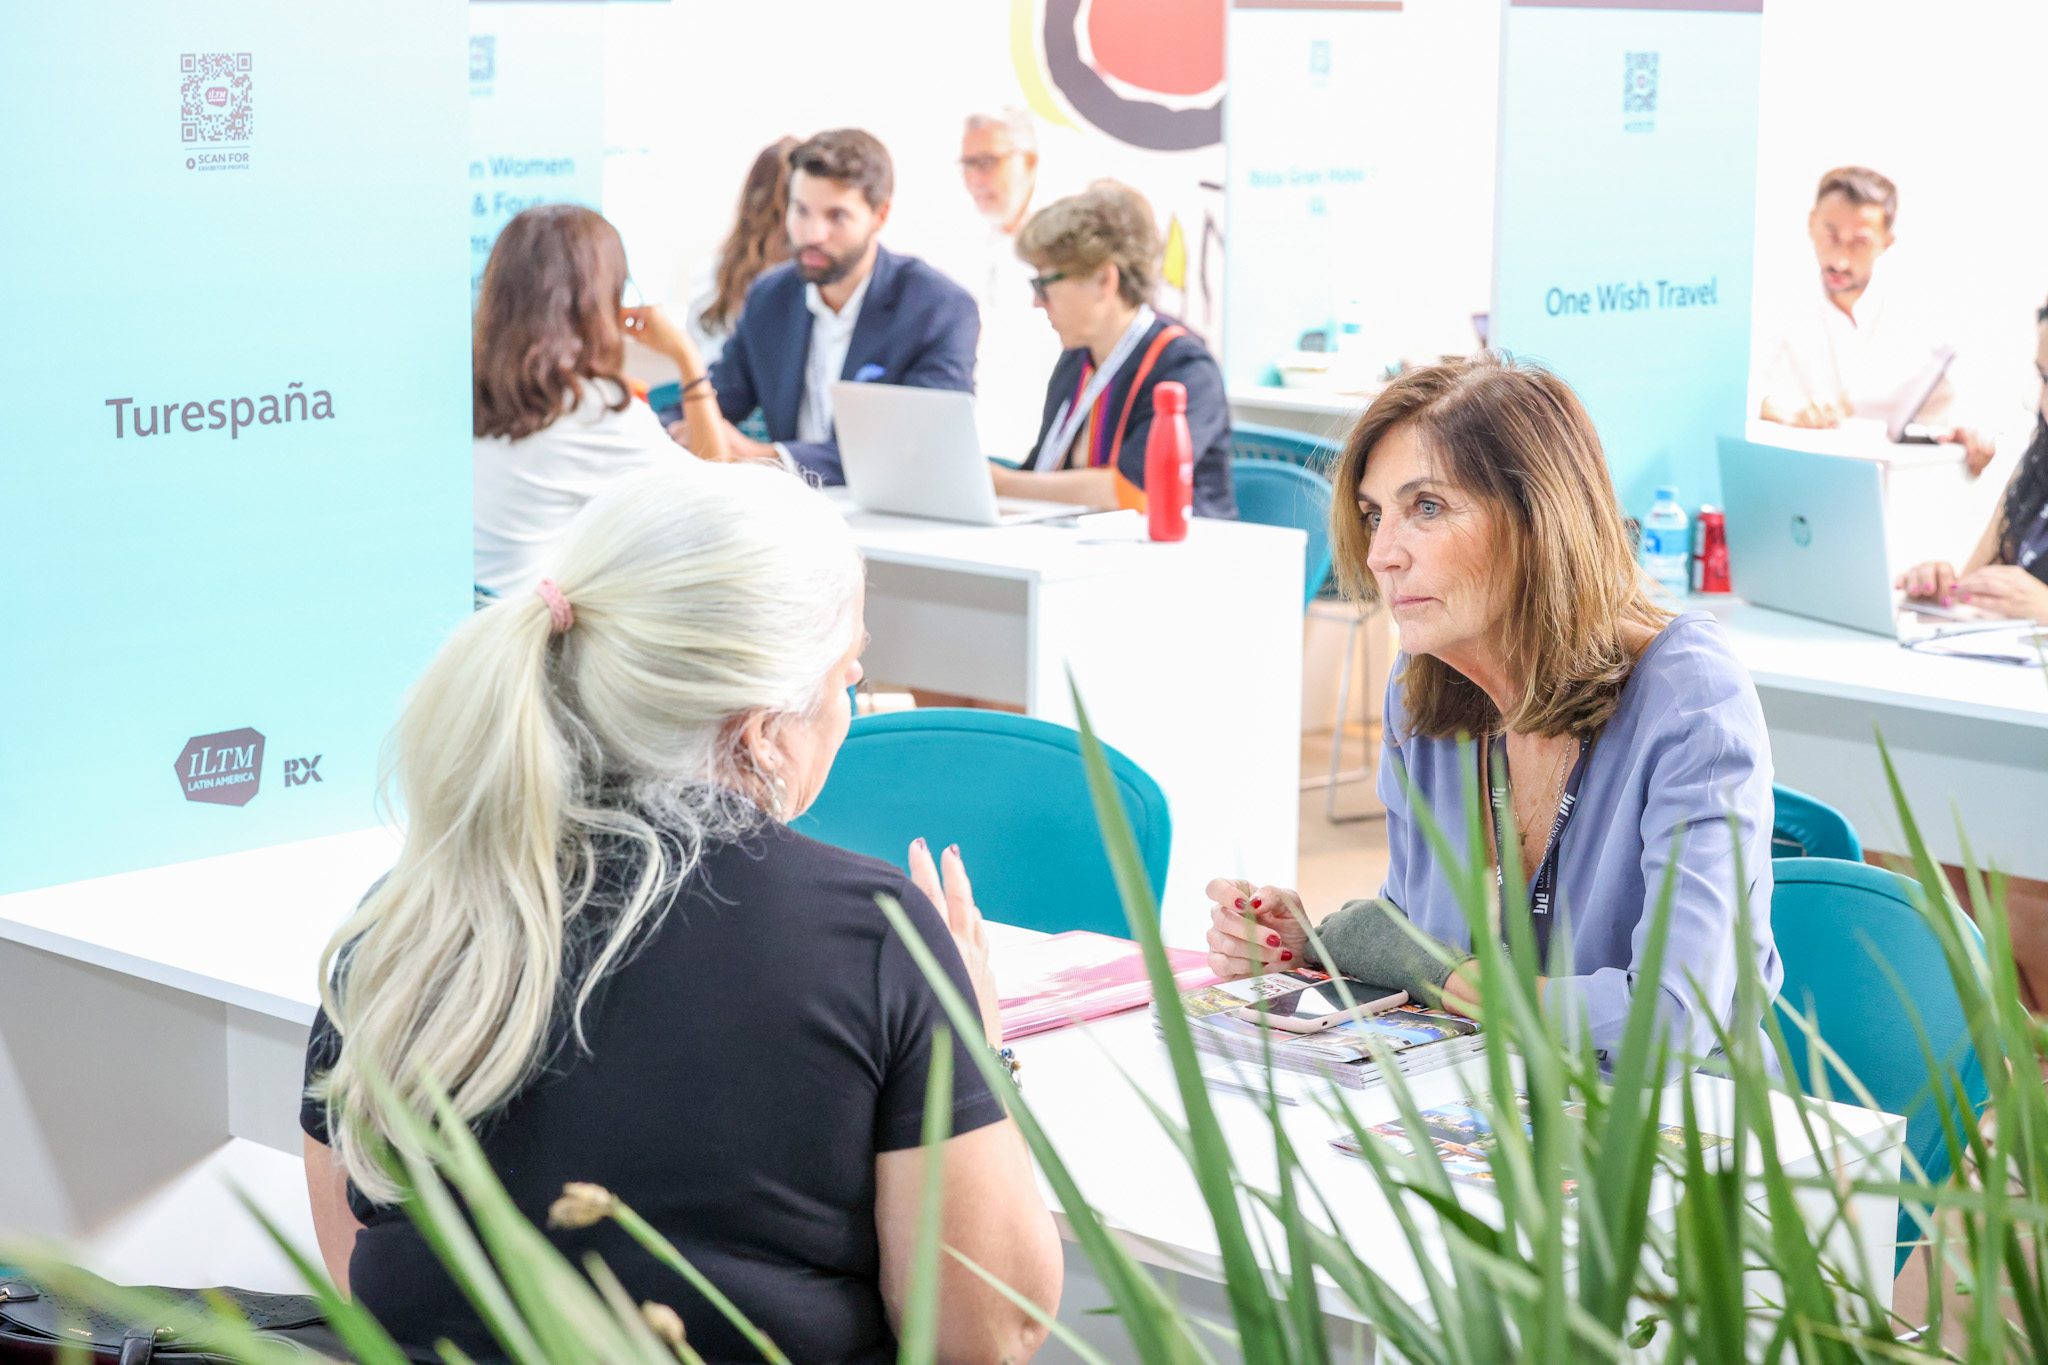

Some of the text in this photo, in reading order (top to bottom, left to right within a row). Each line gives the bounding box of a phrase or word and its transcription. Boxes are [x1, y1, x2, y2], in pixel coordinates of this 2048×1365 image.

[198, 152, 249, 164] SCAN FOR
[489, 157, 575, 178] Women
[472, 194, 487, 215] &
[1545, 275, 1718, 317] One Wish Travel
[105, 382, 335, 440] Turespaña
[284, 754, 323, 787] RX
[188, 771, 255, 792] LATIN AMERICA
